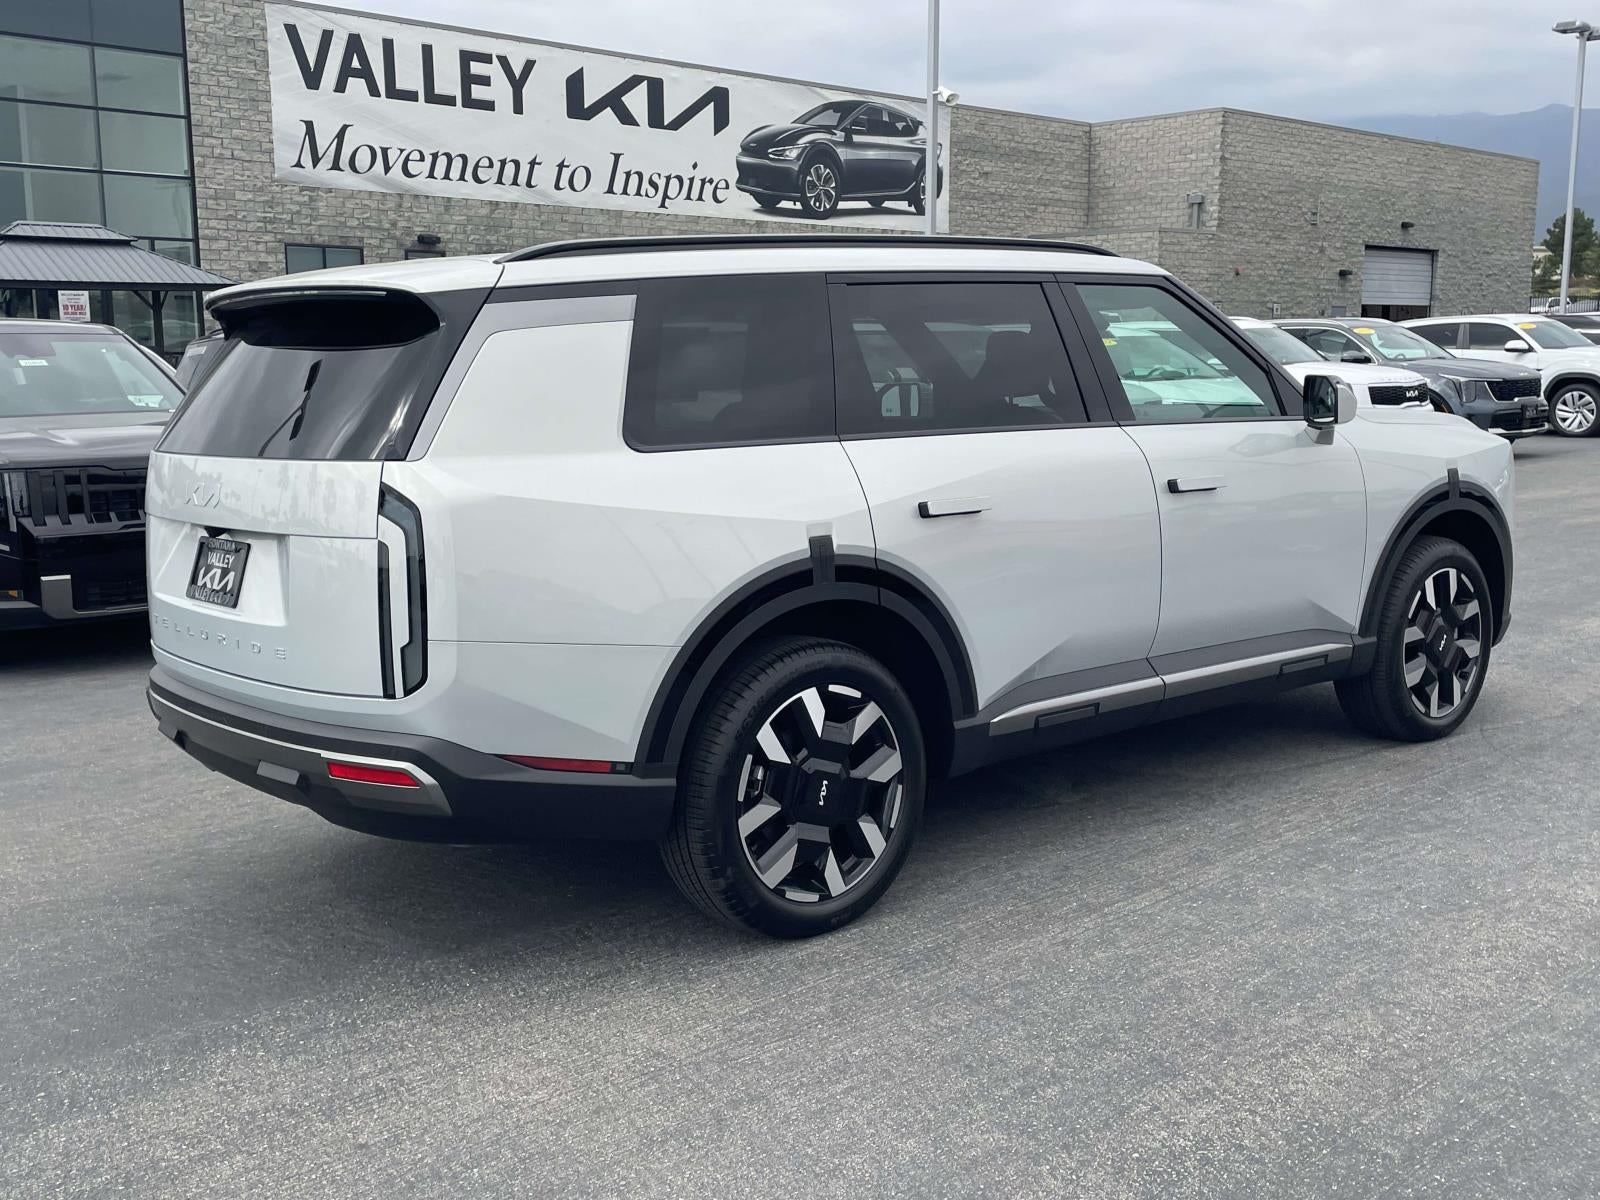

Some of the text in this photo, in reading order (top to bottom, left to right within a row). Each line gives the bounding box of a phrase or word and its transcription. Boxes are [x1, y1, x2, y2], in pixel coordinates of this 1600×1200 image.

[283, 23, 730, 136] VALLEY KIA
[290, 119, 731, 209] Movement to Inspire
[207, 551, 236, 569] VALLEY
[153, 613, 286, 660] TELLURIDE
